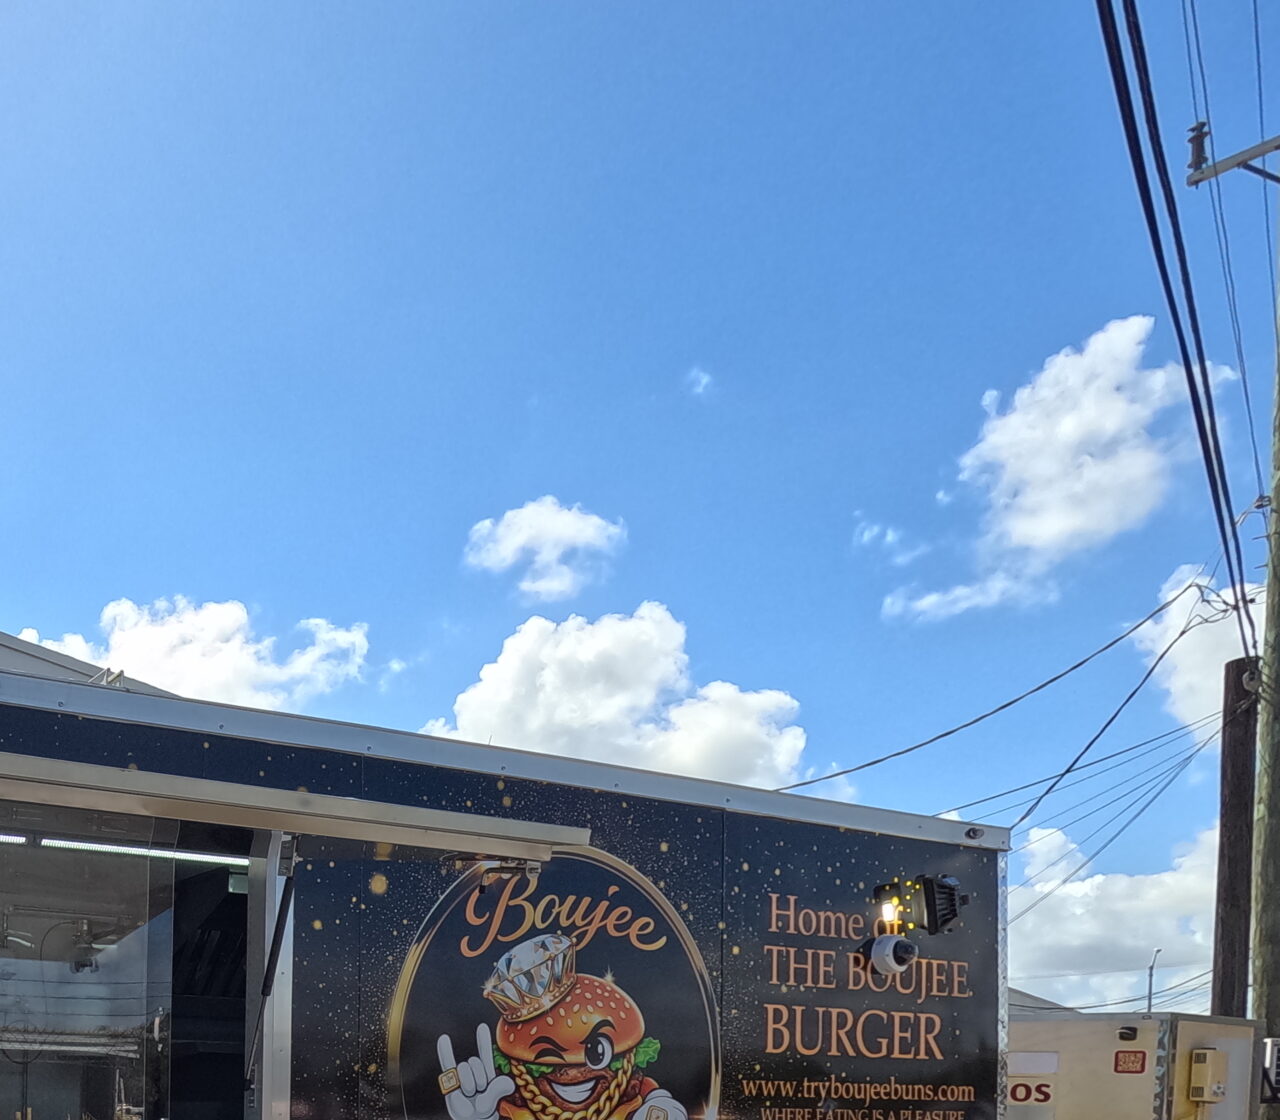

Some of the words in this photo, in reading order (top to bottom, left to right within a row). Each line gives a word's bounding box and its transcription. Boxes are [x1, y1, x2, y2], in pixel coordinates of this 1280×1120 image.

[460, 870, 667, 957] Boujee
[767, 893, 865, 941] Home
[764, 945, 836, 989] THE
[847, 952, 970, 1004] BOUJEE
[764, 1003, 944, 1060] BURGER
[742, 1075, 976, 1107] www.tryboujeebuns.com
